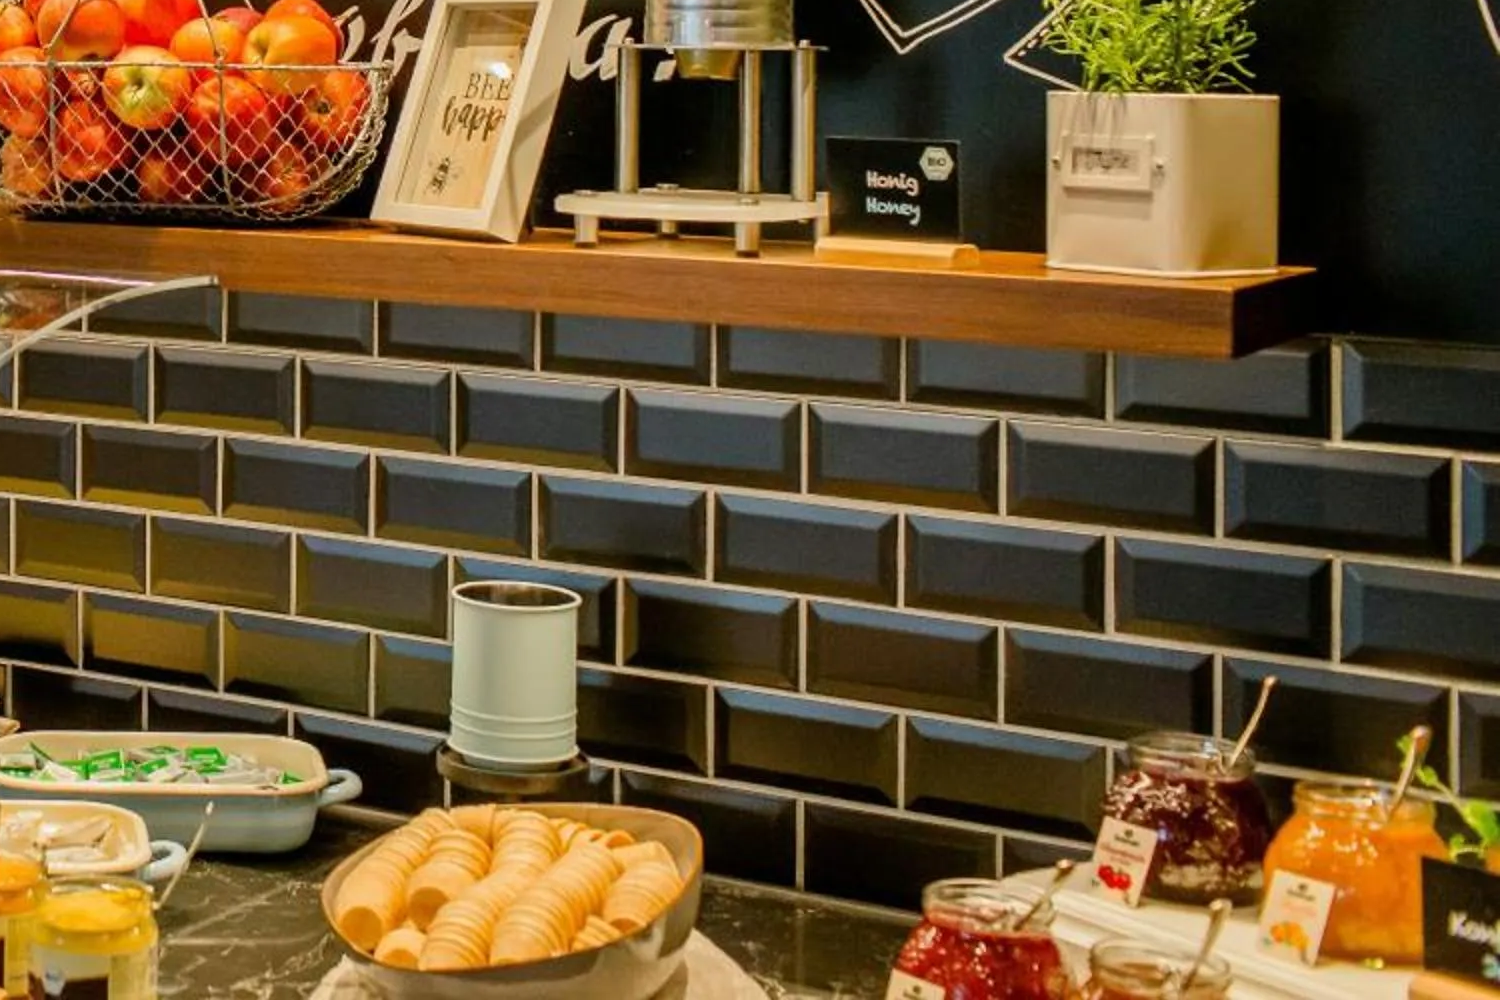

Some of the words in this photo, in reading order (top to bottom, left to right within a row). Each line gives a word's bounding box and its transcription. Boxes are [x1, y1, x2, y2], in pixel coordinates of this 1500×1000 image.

[442, 96, 507, 142] happ
[866, 170, 919, 197] Honig
[866, 196, 921, 227] Honey
